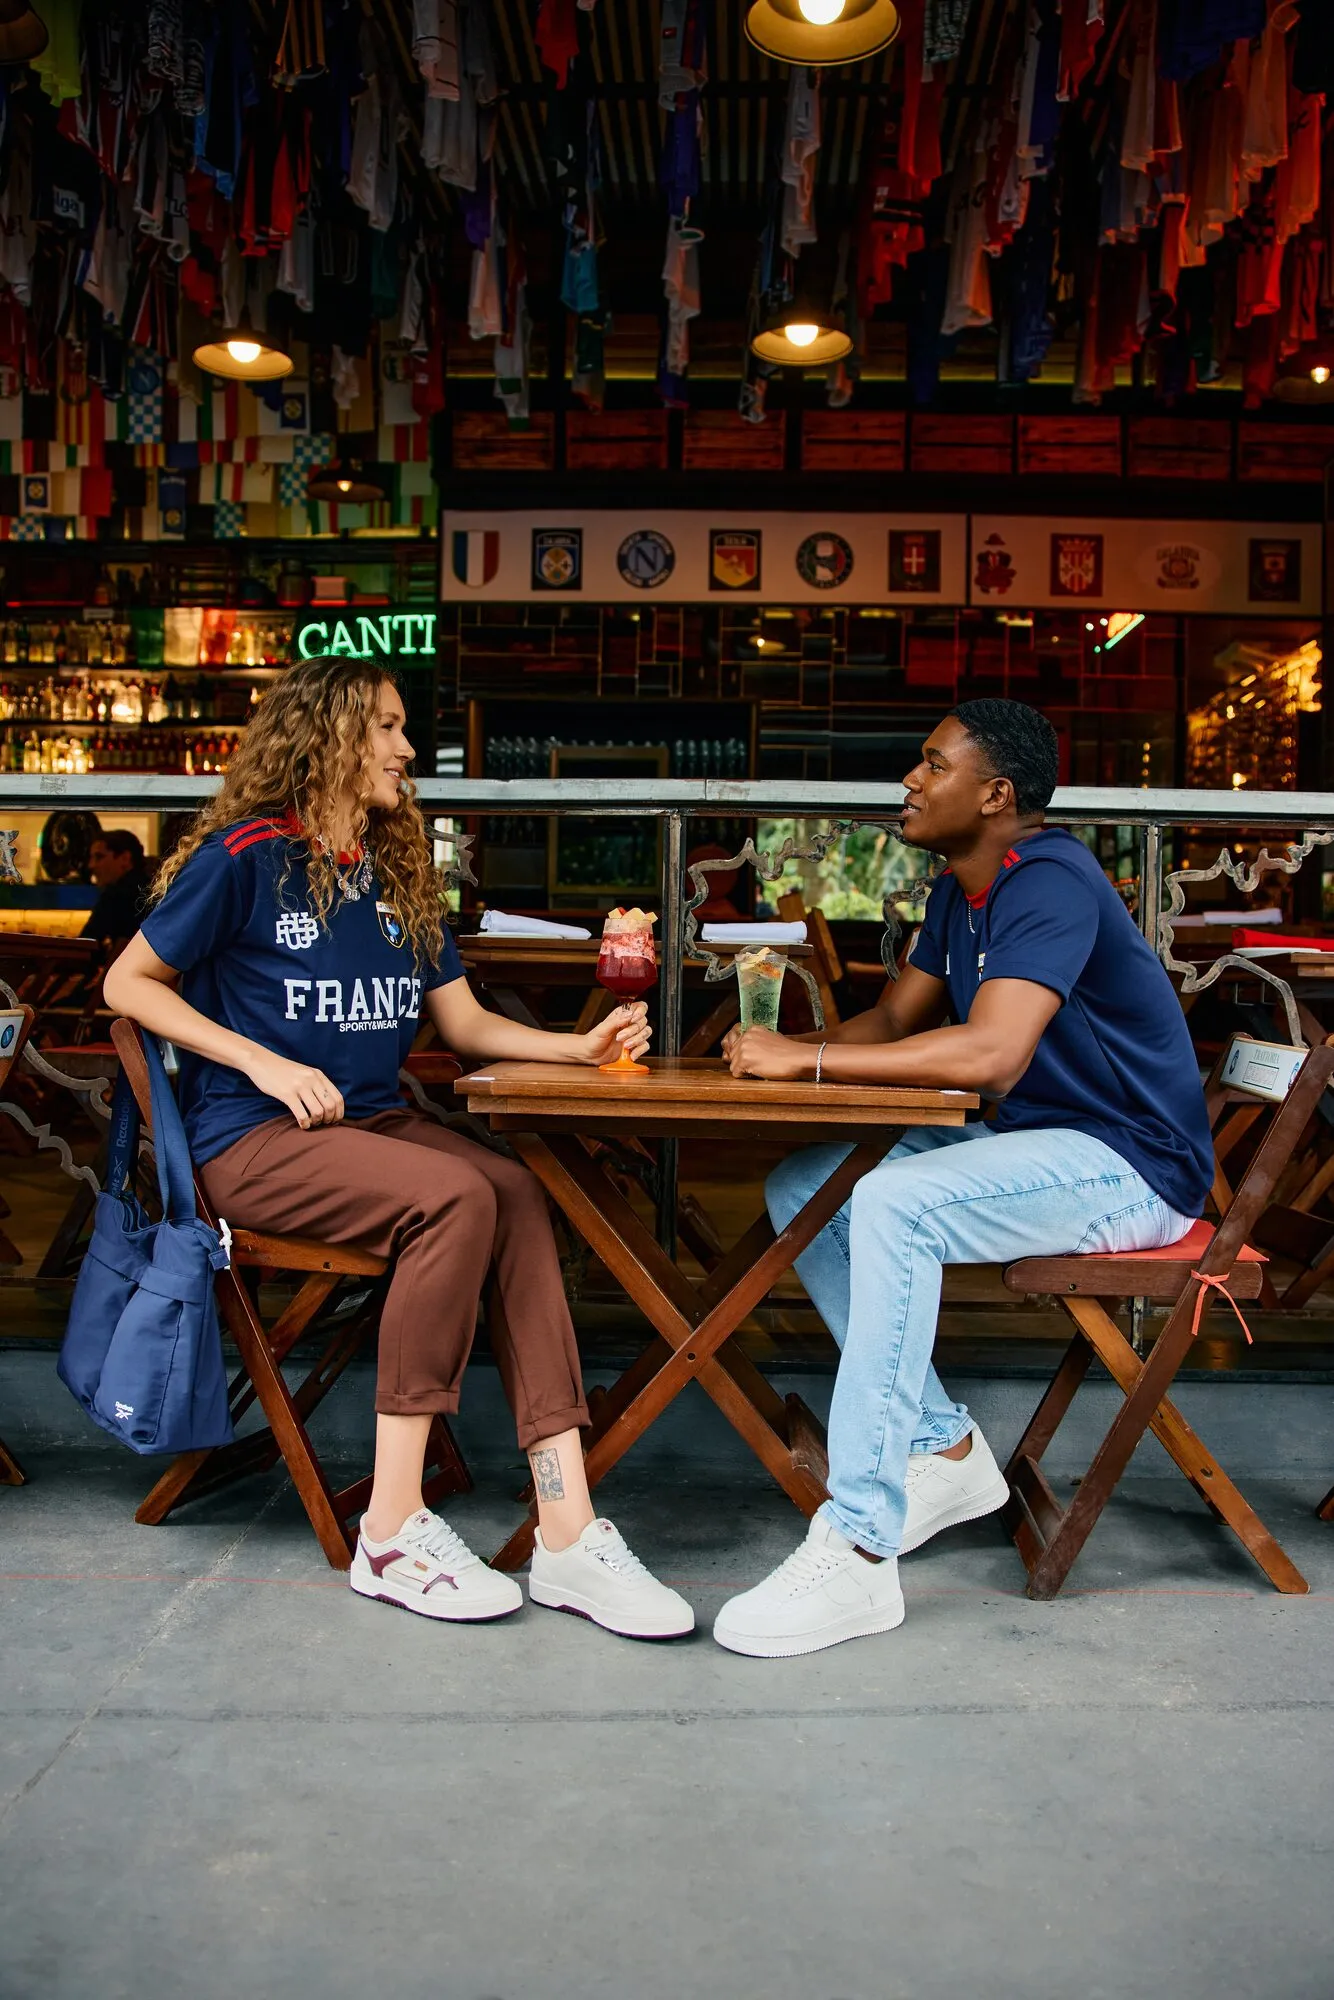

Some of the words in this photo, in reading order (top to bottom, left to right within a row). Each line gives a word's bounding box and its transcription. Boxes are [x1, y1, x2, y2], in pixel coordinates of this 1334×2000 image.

[298, 614, 437, 660] CANTI
[283, 977, 421, 1023] FRANCE
[339, 1020, 398, 1032] SPORTY&WEAR
[116, 1094, 133, 1149] Reebok
